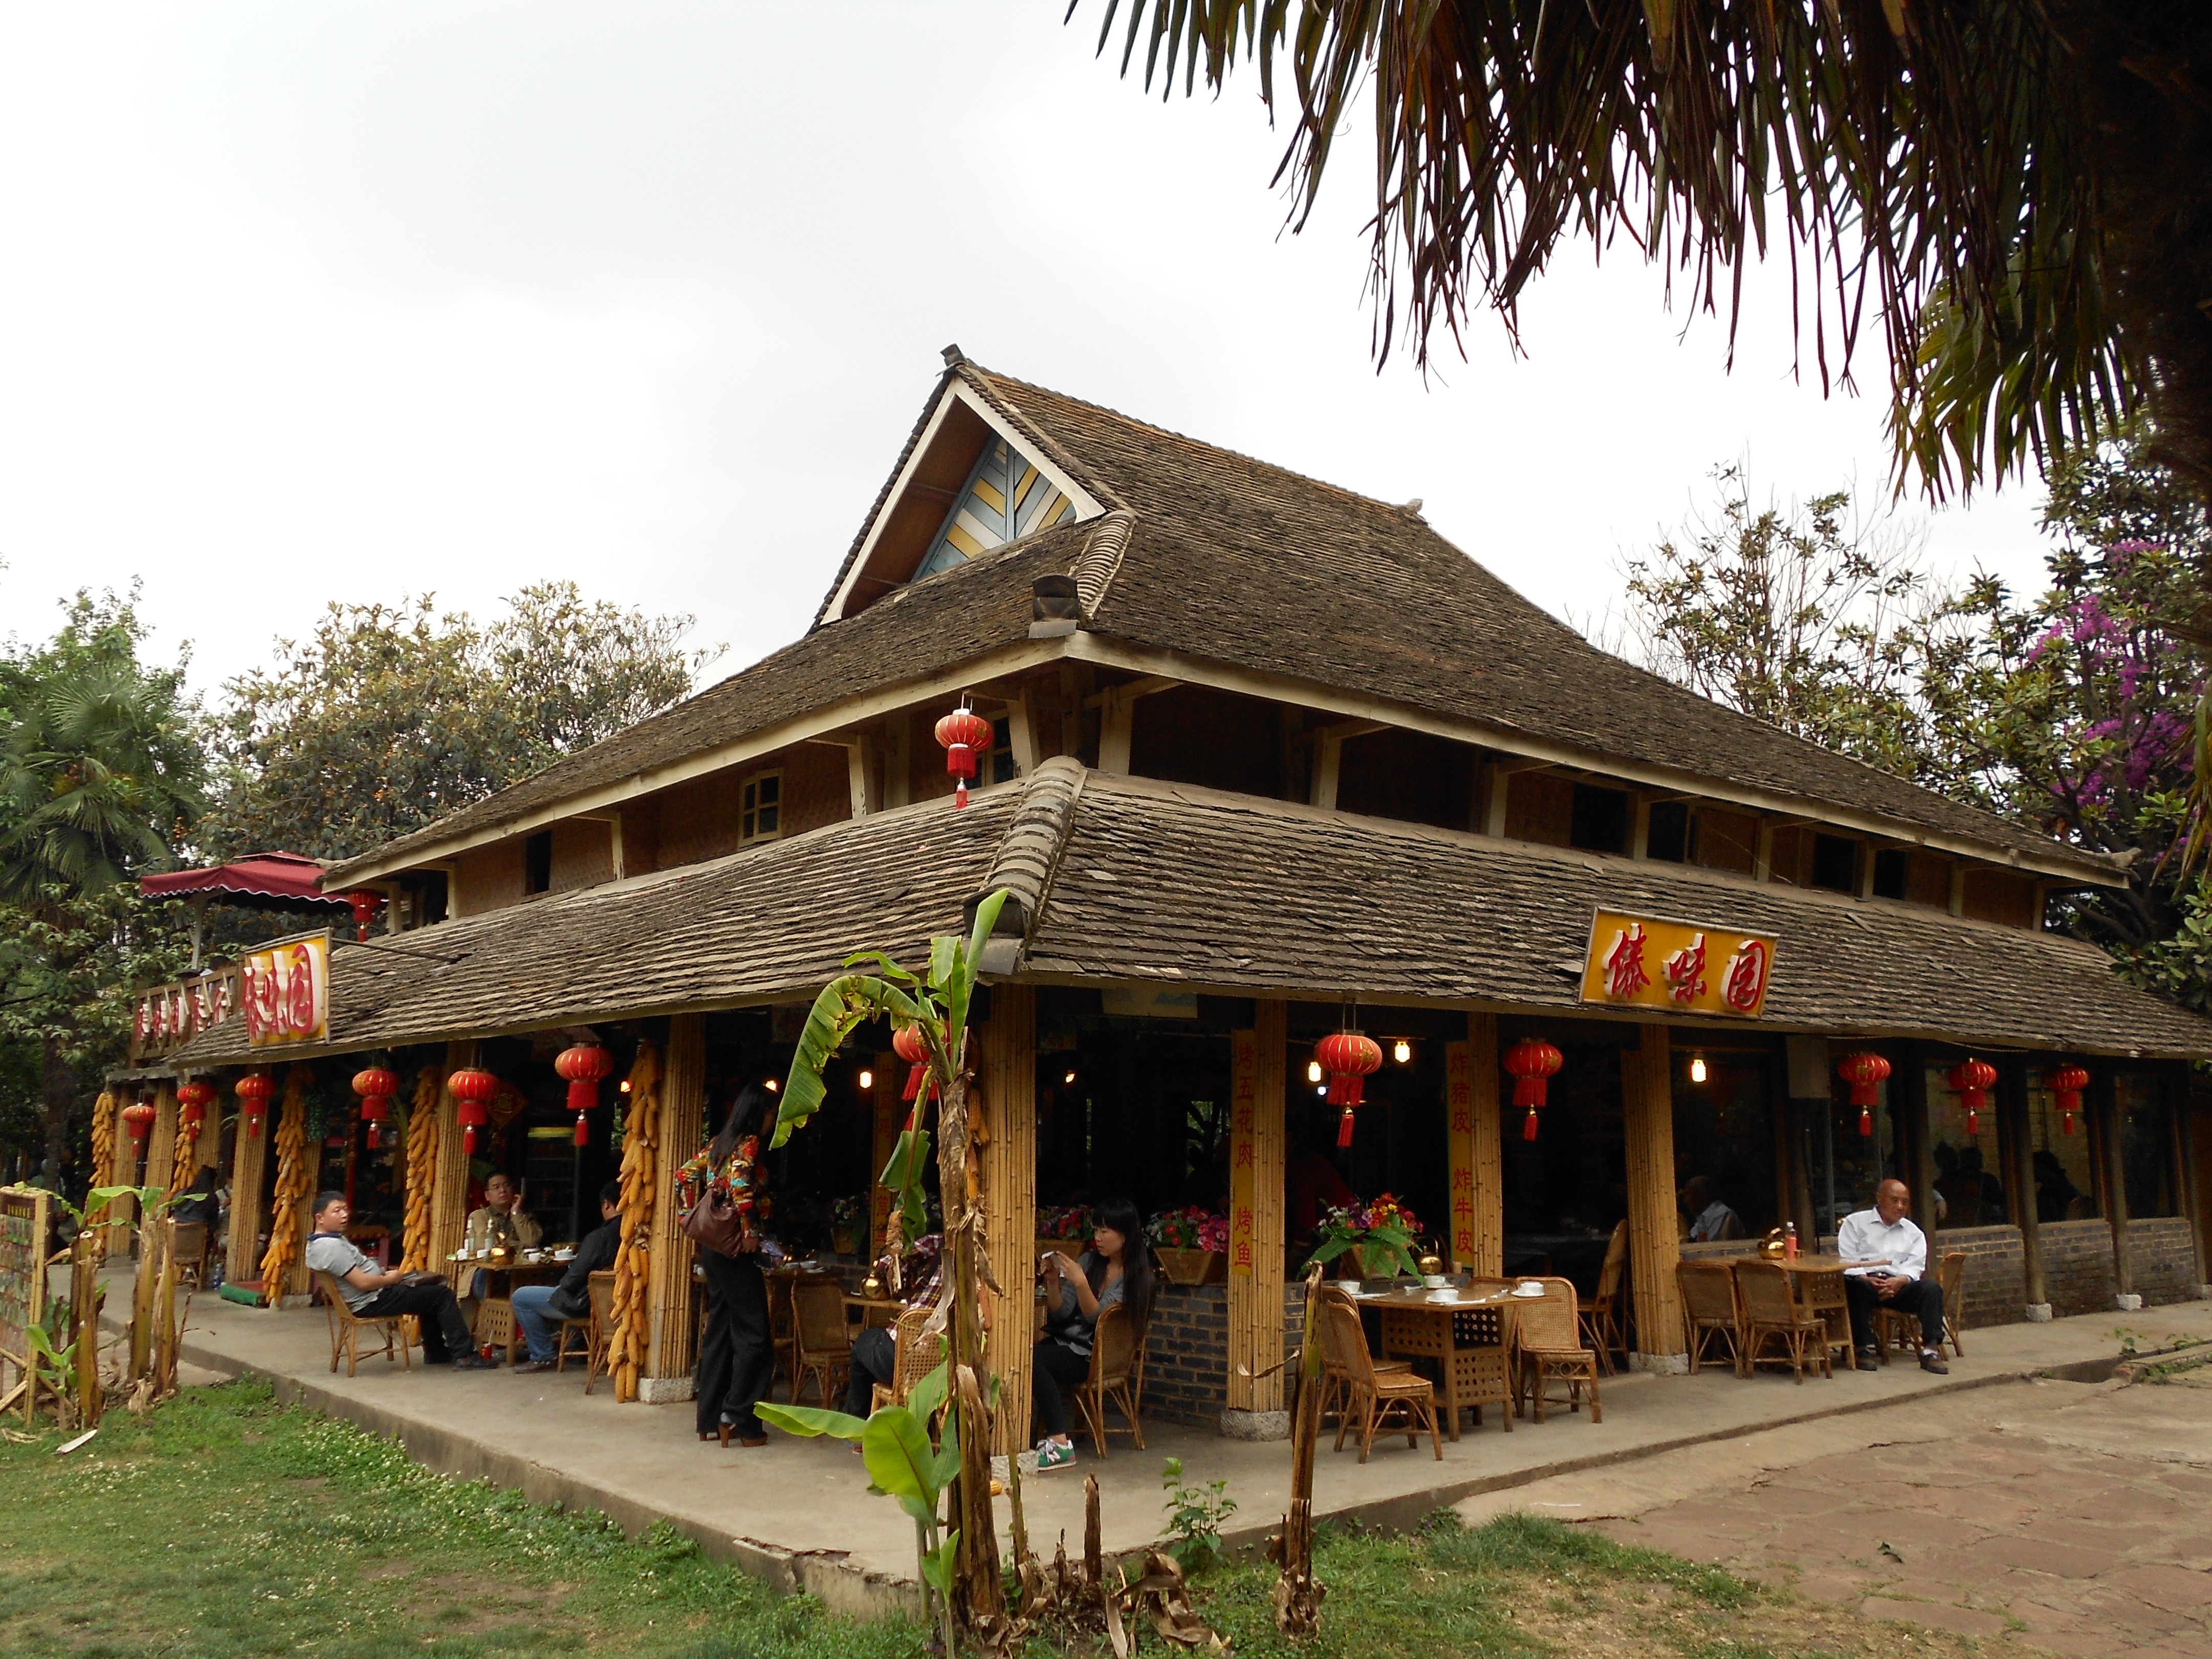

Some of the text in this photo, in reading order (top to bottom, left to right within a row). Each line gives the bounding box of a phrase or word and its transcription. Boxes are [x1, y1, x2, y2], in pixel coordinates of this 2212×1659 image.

[242, 943, 323, 1039] 傣味园
[1603, 923, 1765, 1011] 傣味园
[1234, 1043, 1254, 1267] 烤五花肉 烤鱼
[1449, 1052, 1474, 1254] 炸猪皮 炸牛皮
